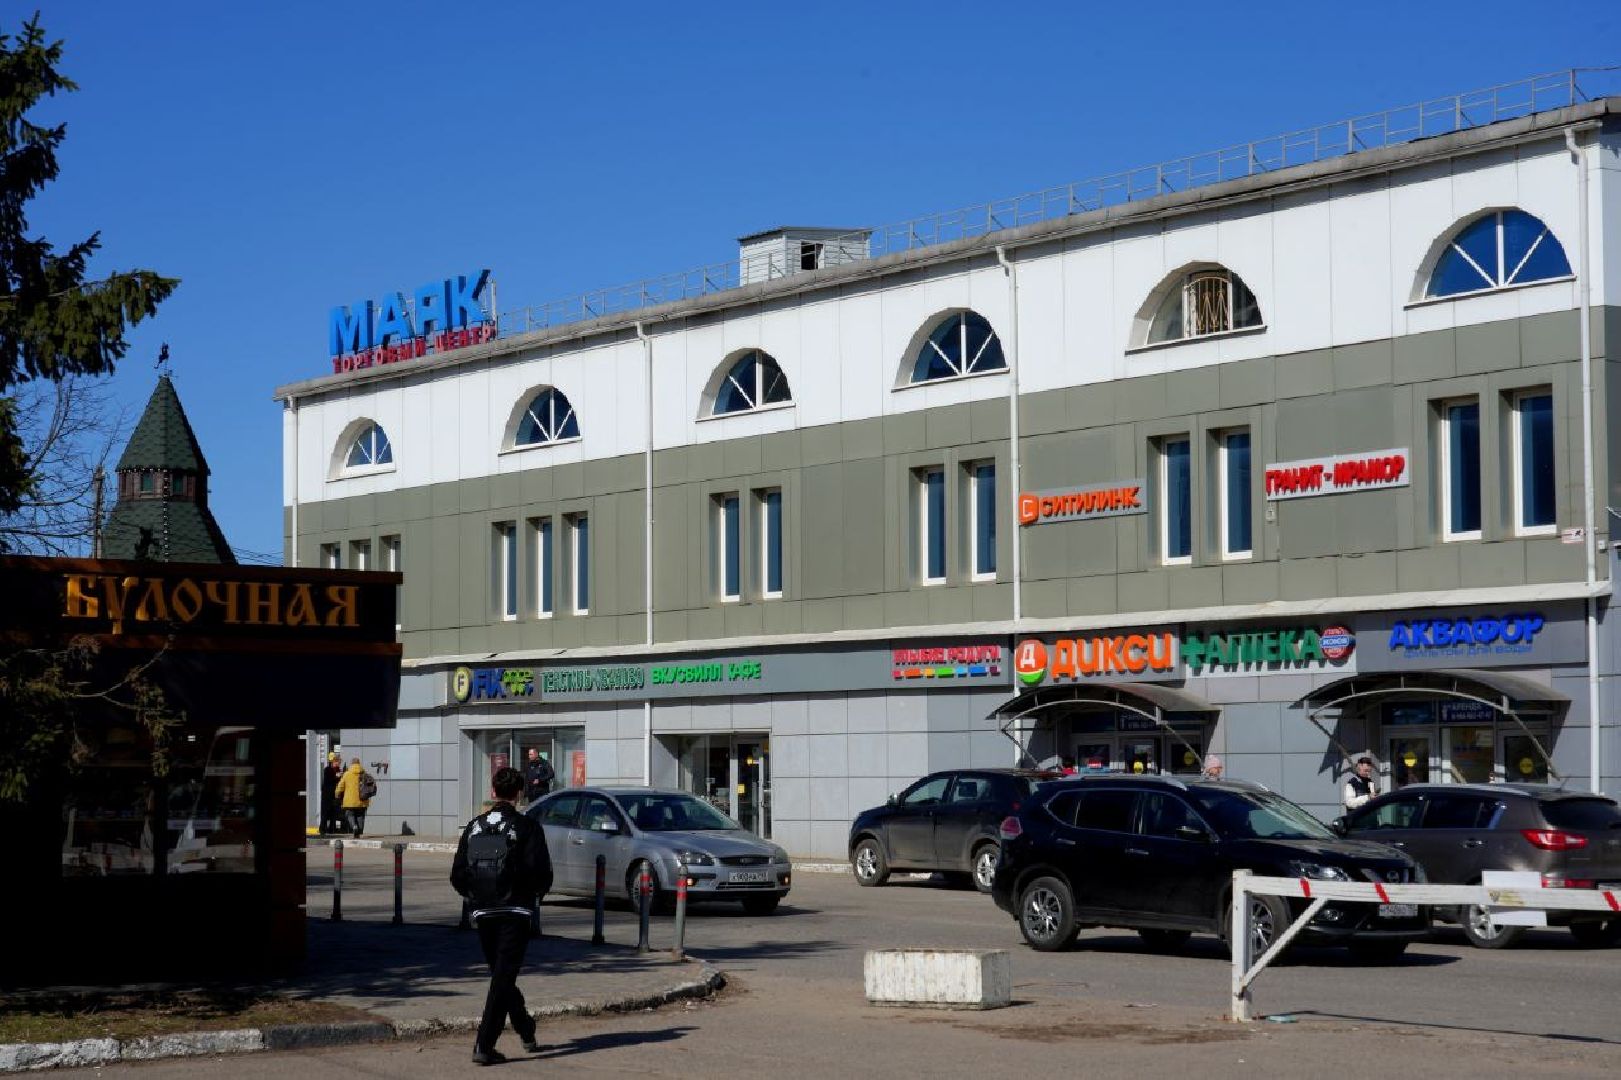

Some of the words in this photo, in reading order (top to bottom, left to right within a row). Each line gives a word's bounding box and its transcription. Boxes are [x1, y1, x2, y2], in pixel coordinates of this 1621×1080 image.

[330, 269, 491, 356] МАЯК
[1041, 487, 1141, 517] СИТИЛИНК
[62, 573, 361, 634] БУЛОЧНАЯ
[1206, 630, 1323, 666] АПТЕКА
[1389, 613, 1544, 650] АКВАФОР
[652, 664, 723, 684] ВКУСВИЛЛ
[727, 660, 762, 681] КАФЕ
[1051, 633, 1173, 681] ДИКСИ
